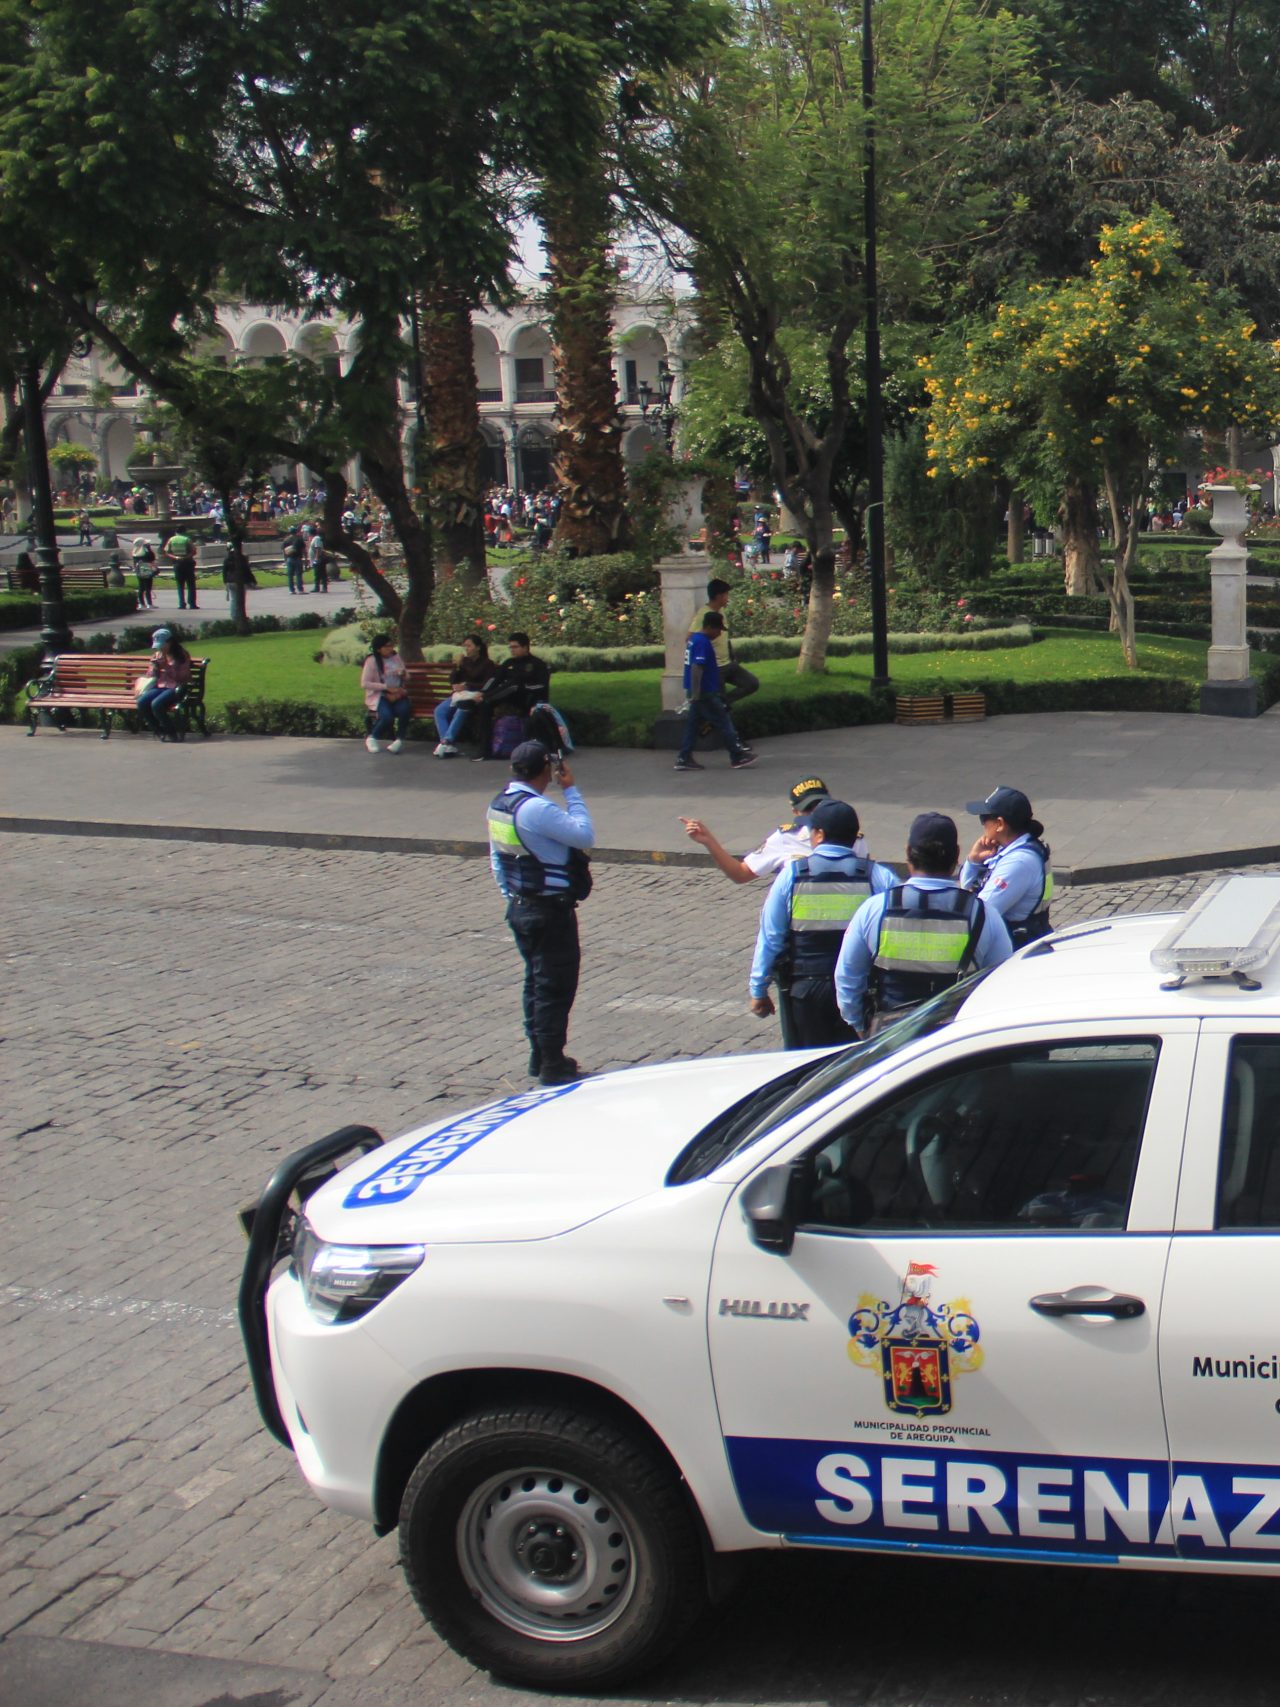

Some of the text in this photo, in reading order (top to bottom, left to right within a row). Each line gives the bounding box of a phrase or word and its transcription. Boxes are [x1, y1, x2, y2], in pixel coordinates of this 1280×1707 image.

[719, 1298, 810, 1321] HILUX
[854, 1420, 991, 1437] MUNICIPALIDAD PROVINCIAL
[890, 1431, 955, 1443] DE AREQUIPA
